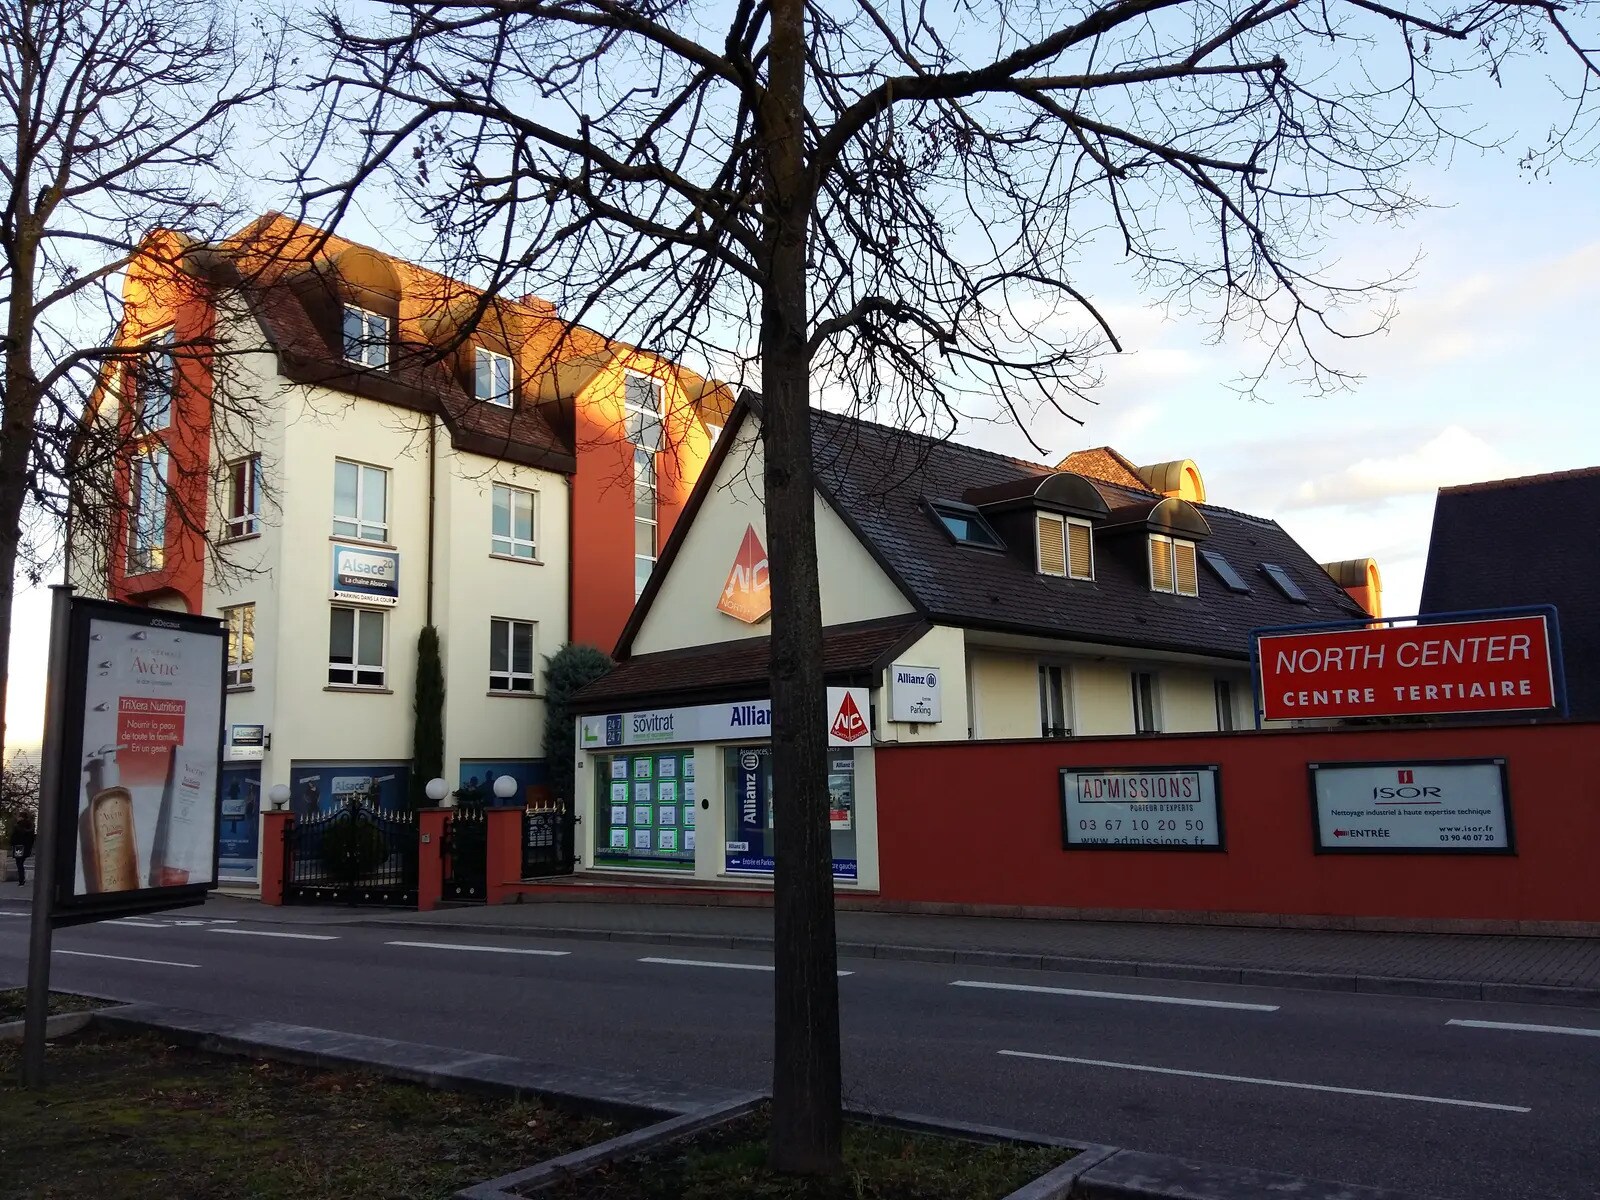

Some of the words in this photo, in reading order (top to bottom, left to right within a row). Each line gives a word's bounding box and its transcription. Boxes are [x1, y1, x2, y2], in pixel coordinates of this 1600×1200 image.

[342, 558, 385, 576] Alsace
[383, 560, 393, 569] 20
[149, 618, 181, 629] JCDecaux
[1275, 643, 1385, 675] NORTH
[1396, 634, 1531, 668] CENTER
[130, 655, 179, 677] Avène
[897, 673, 925, 685] Allianz
[1283, 688, 1375, 706] CENTRE
[1394, 680, 1531, 702] TERTIAIRE
[121, 699, 148, 711] TriXera
[150, 702, 184, 713] Nutrition
[910, 706, 931, 717] Parking
[159, 722, 176, 733] peau
[633, 713, 674, 733] sovitrat
[121, 731, 131, 740] de
[131, 743, 140, 752] En
[142, 745, 150, 753] un
[335, 781, 365, 791] Alsace
[743, 773, 757, 824] Allianz
[1373, 786, 1442, 800] ISOR
[1130, 804, 1158, 812] PORTEUR
[1159, 804, 1194, 812] D'EXPERTS
[1331, 809, 1365, 817] Nettoyage
[1403, 808, 1422, 816] haute
[1424, 808, 1456, 817] expertise
[1457, 808, 1491, 816] technique
[1079, 820, 1097, 831] 03
[1105, 819, 1122, 831] 67
[1132, 819, 1149, 831] 10
[1158, 819, 1176, 831] 20
[1185, 819, 1204, 831] 50
[1350, 828, 1390, 838] ENTRÉE
[839, 861, 857, 871] gauche
